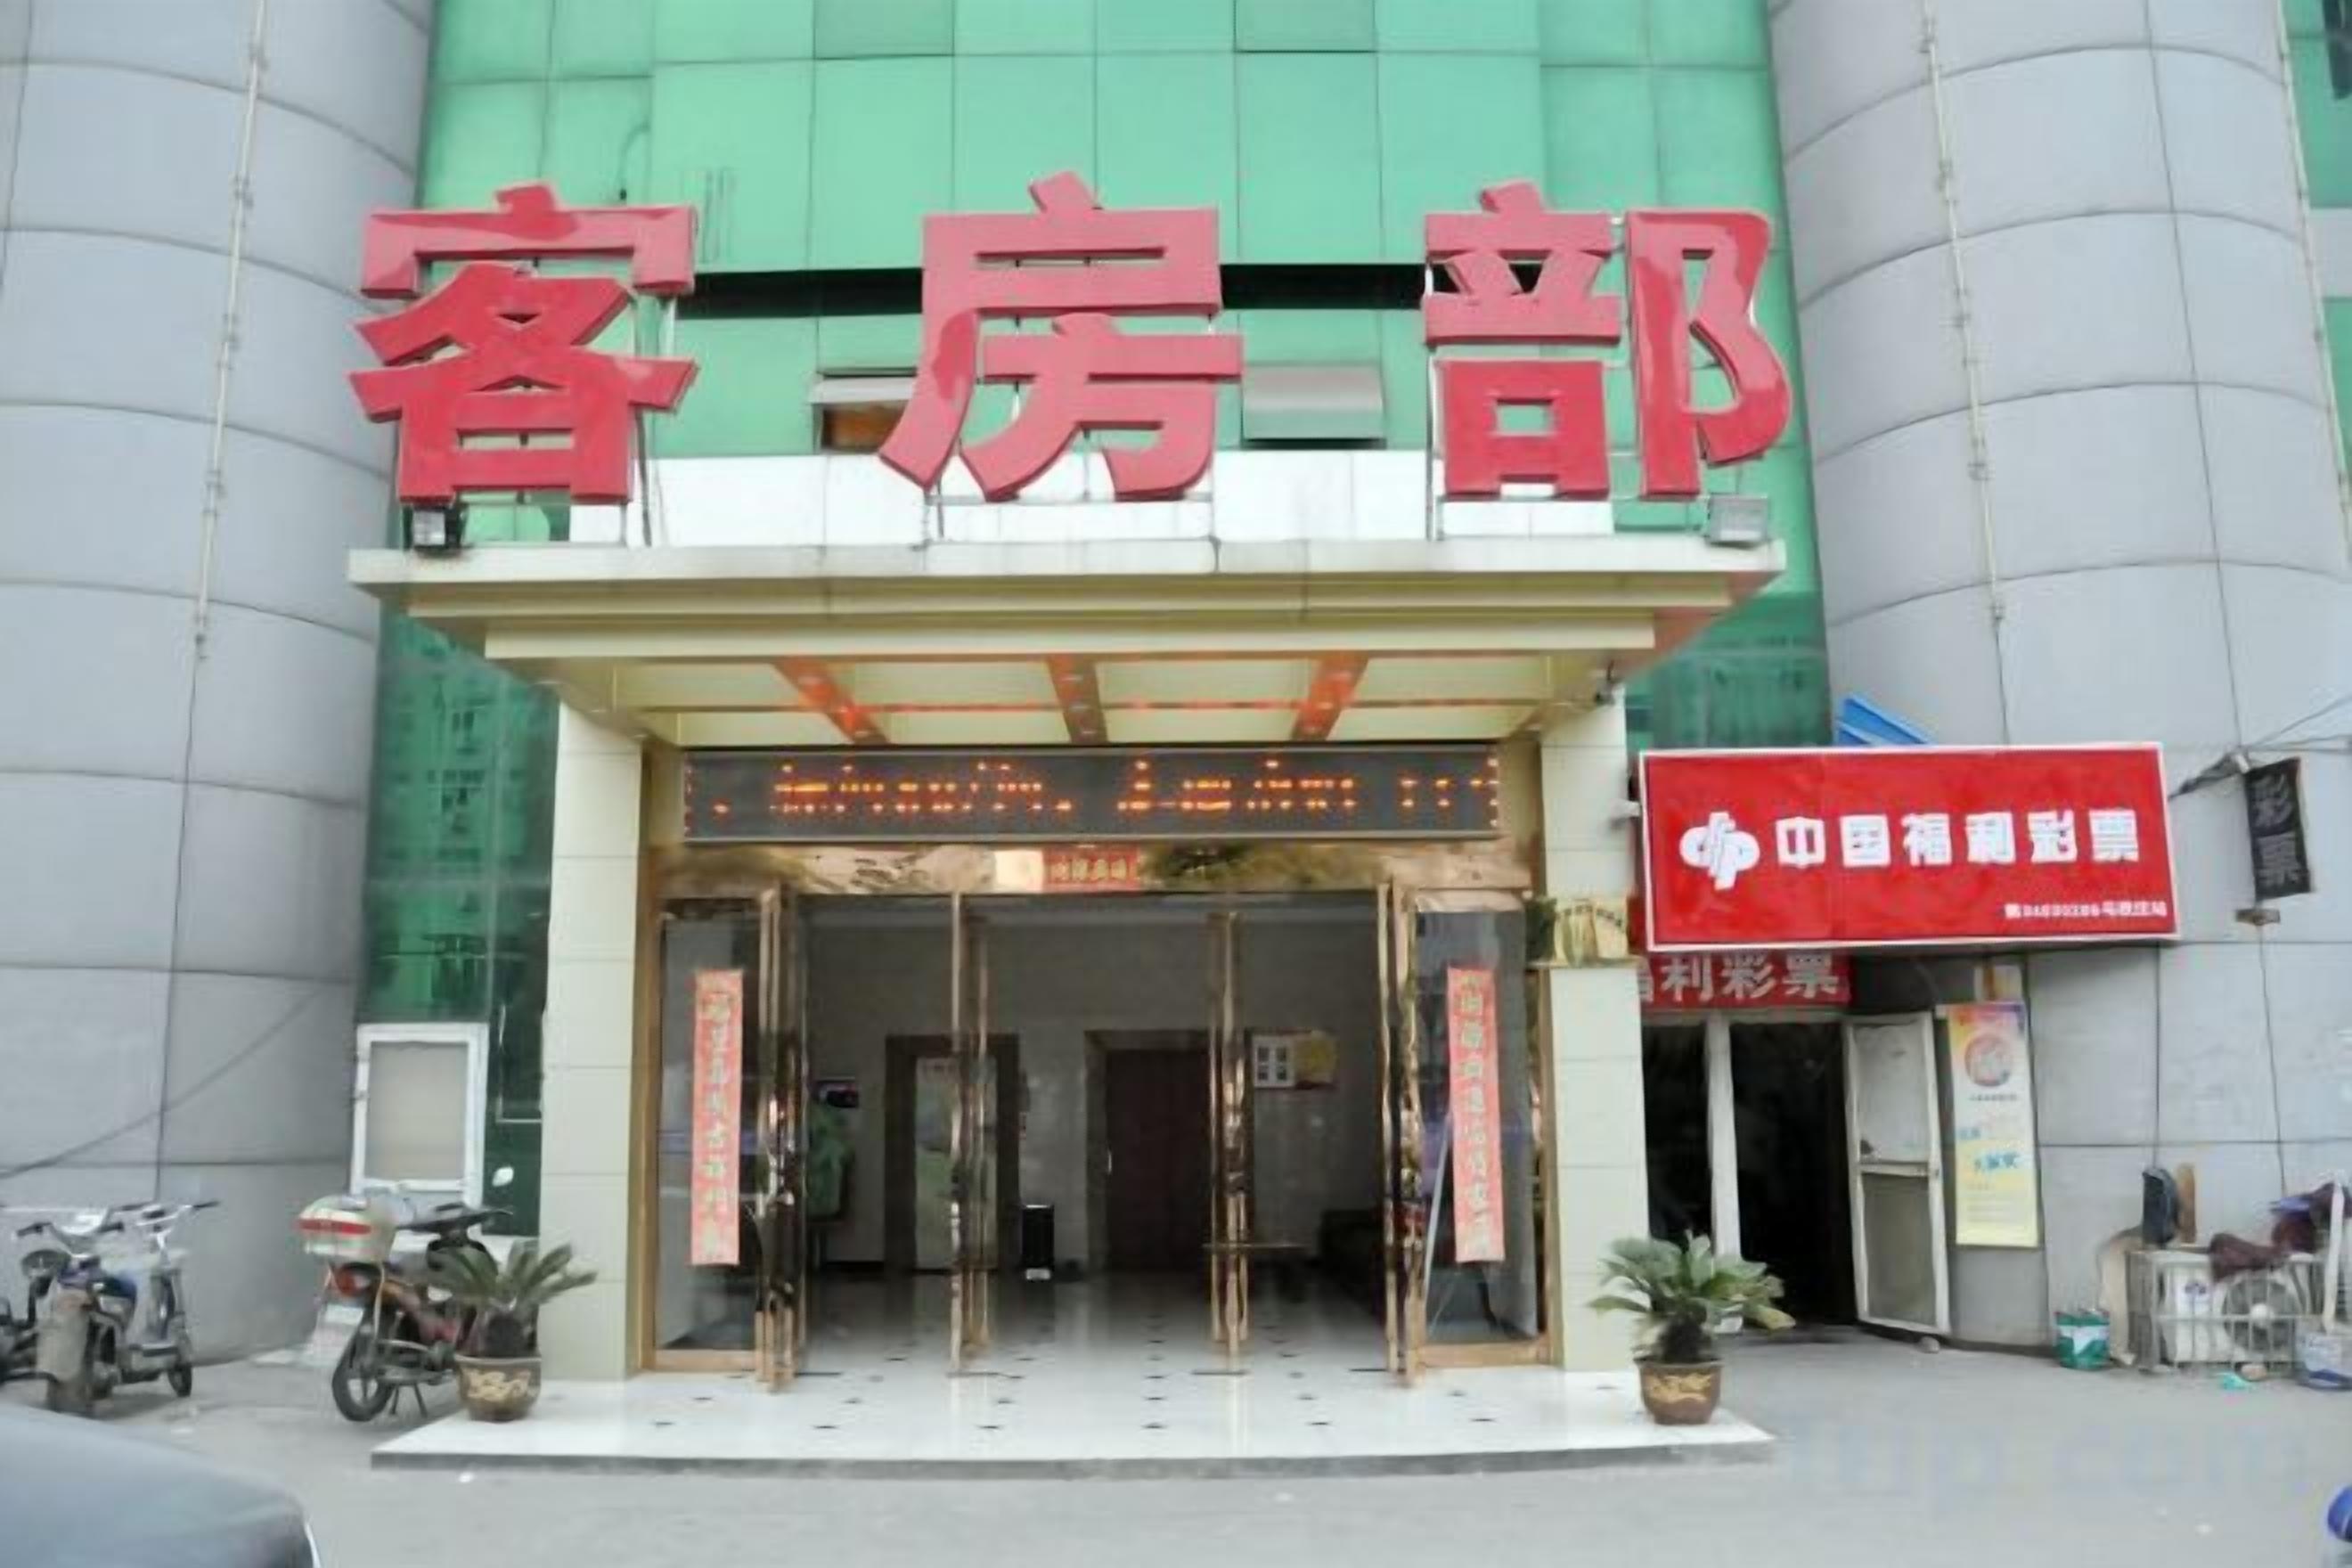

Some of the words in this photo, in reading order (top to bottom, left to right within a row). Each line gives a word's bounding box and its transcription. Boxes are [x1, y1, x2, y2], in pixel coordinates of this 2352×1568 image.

[348, 172, 1789, 502] 客房部
[1776, 809, 2138, 869] 中国福利彩票
